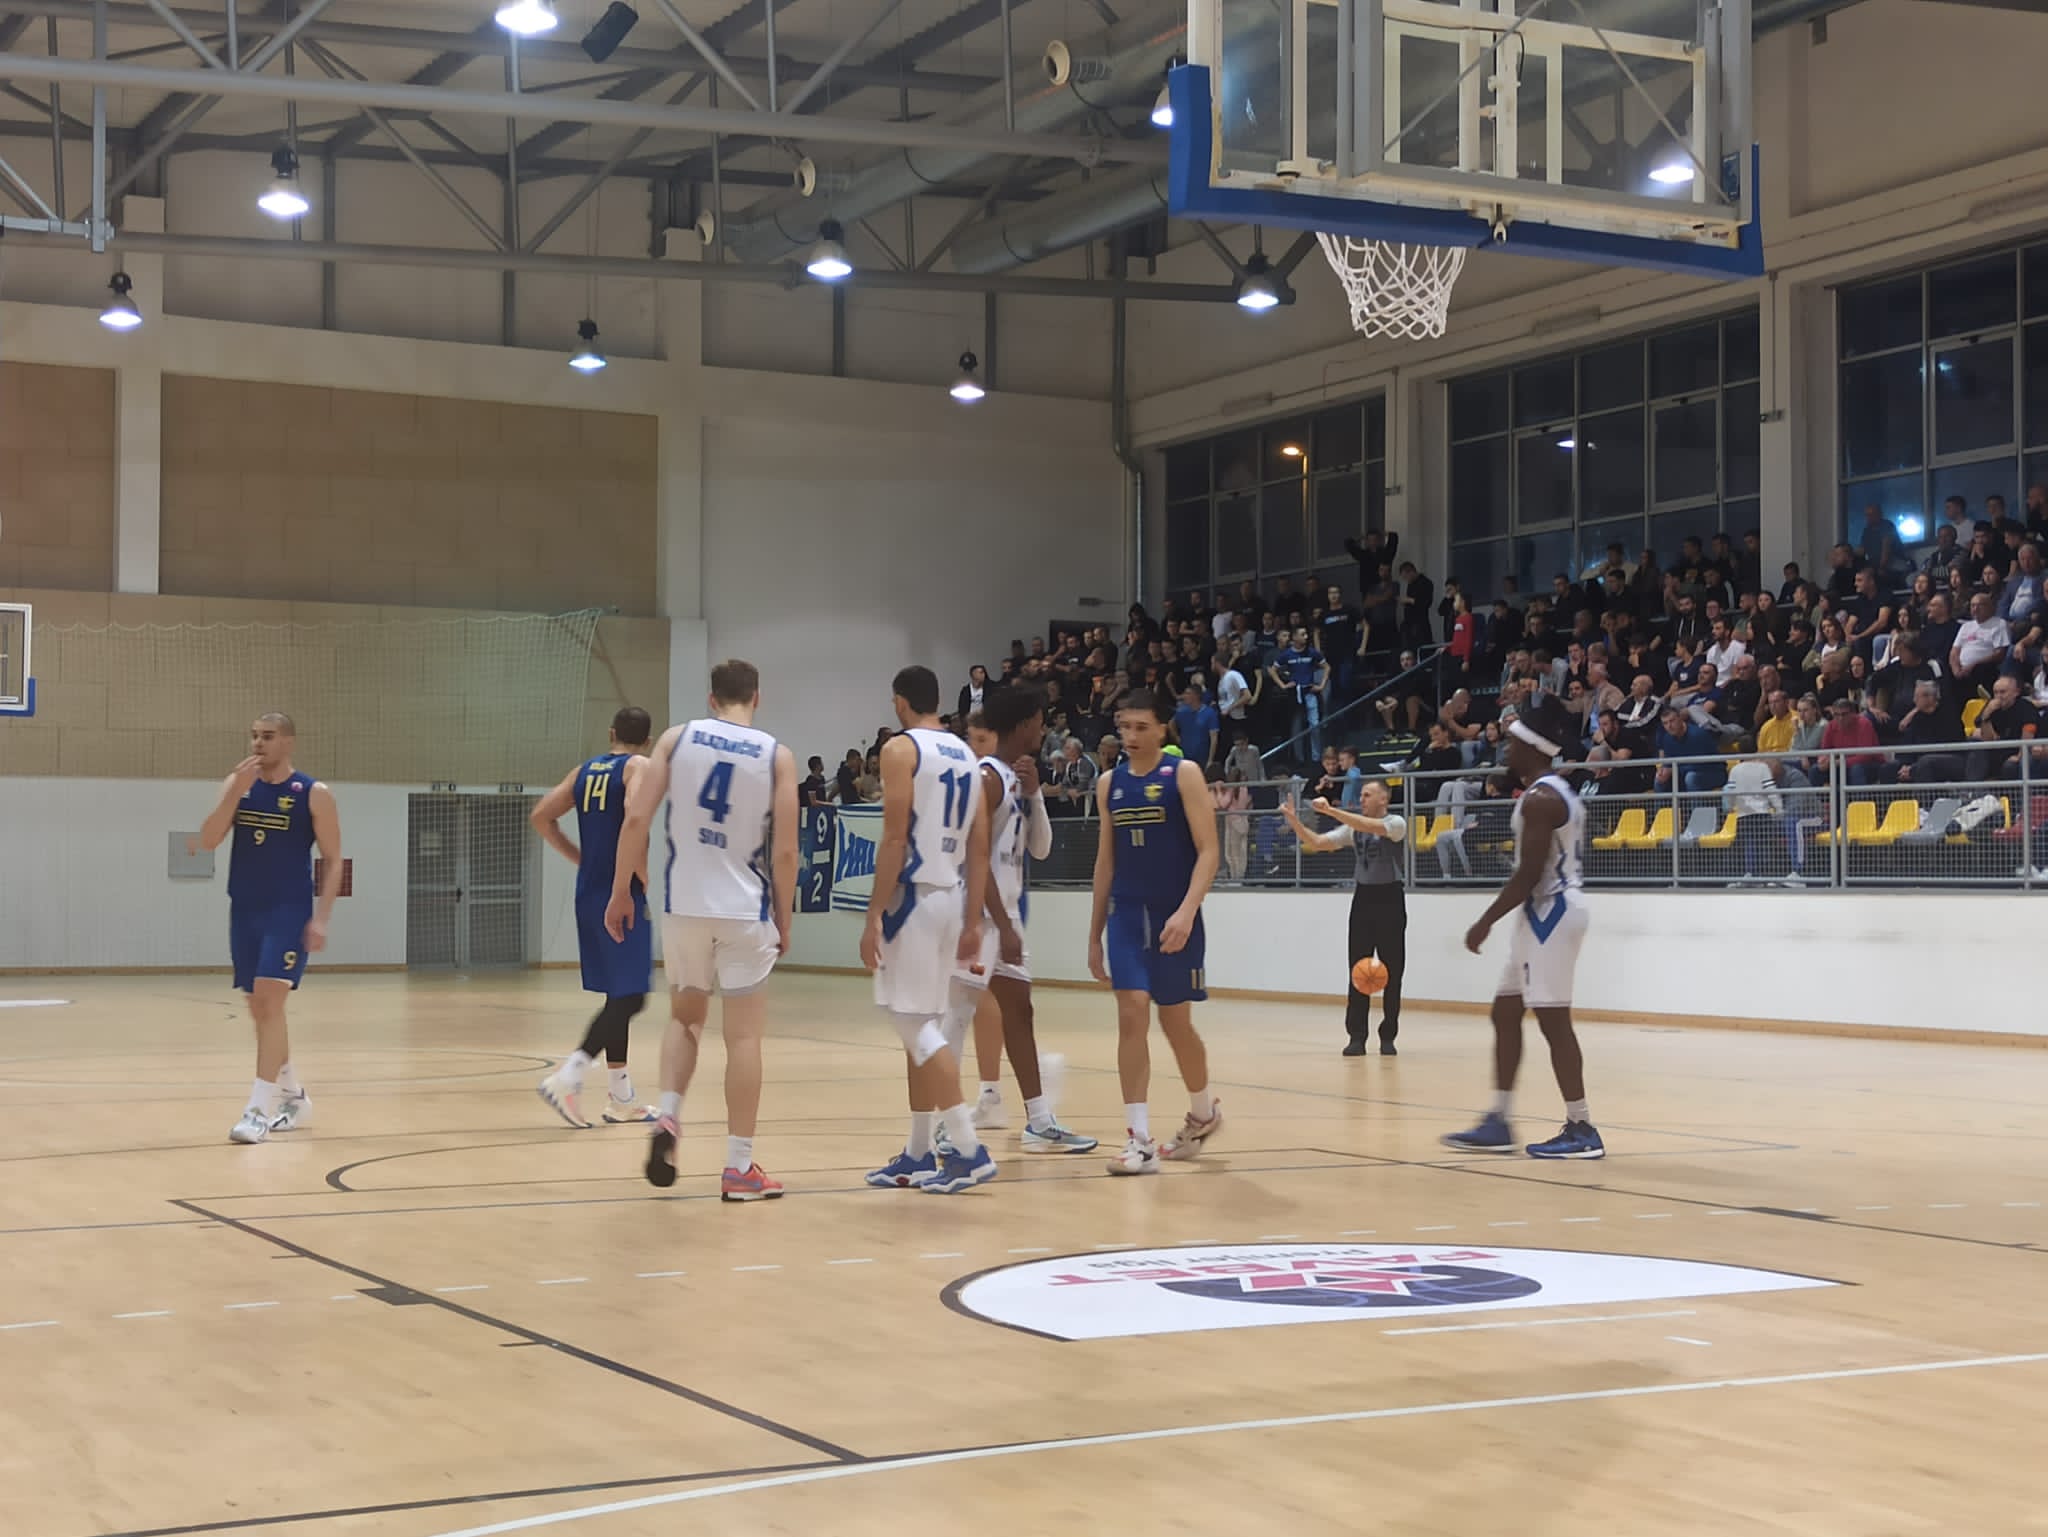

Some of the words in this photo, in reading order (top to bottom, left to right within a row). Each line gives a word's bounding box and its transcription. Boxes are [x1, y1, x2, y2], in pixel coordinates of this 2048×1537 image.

[583, 773, 610, 813] 14
[697, 760, 736, 824] 4
[938, 767, 972, 830] 11
[254, 829, 267, 846] 9
[816, 811, 828, 844] 9
[1130, 828, 1145, 847] 11
[811, 871, 823, 904] 2
[283, 951, 297, 971] 9
[1048, 1251, 1500, 1286] FAVBET
[1087, 1258, 1178, 1269] liga
[1186, 1249, 1373, 1263] Premijer
